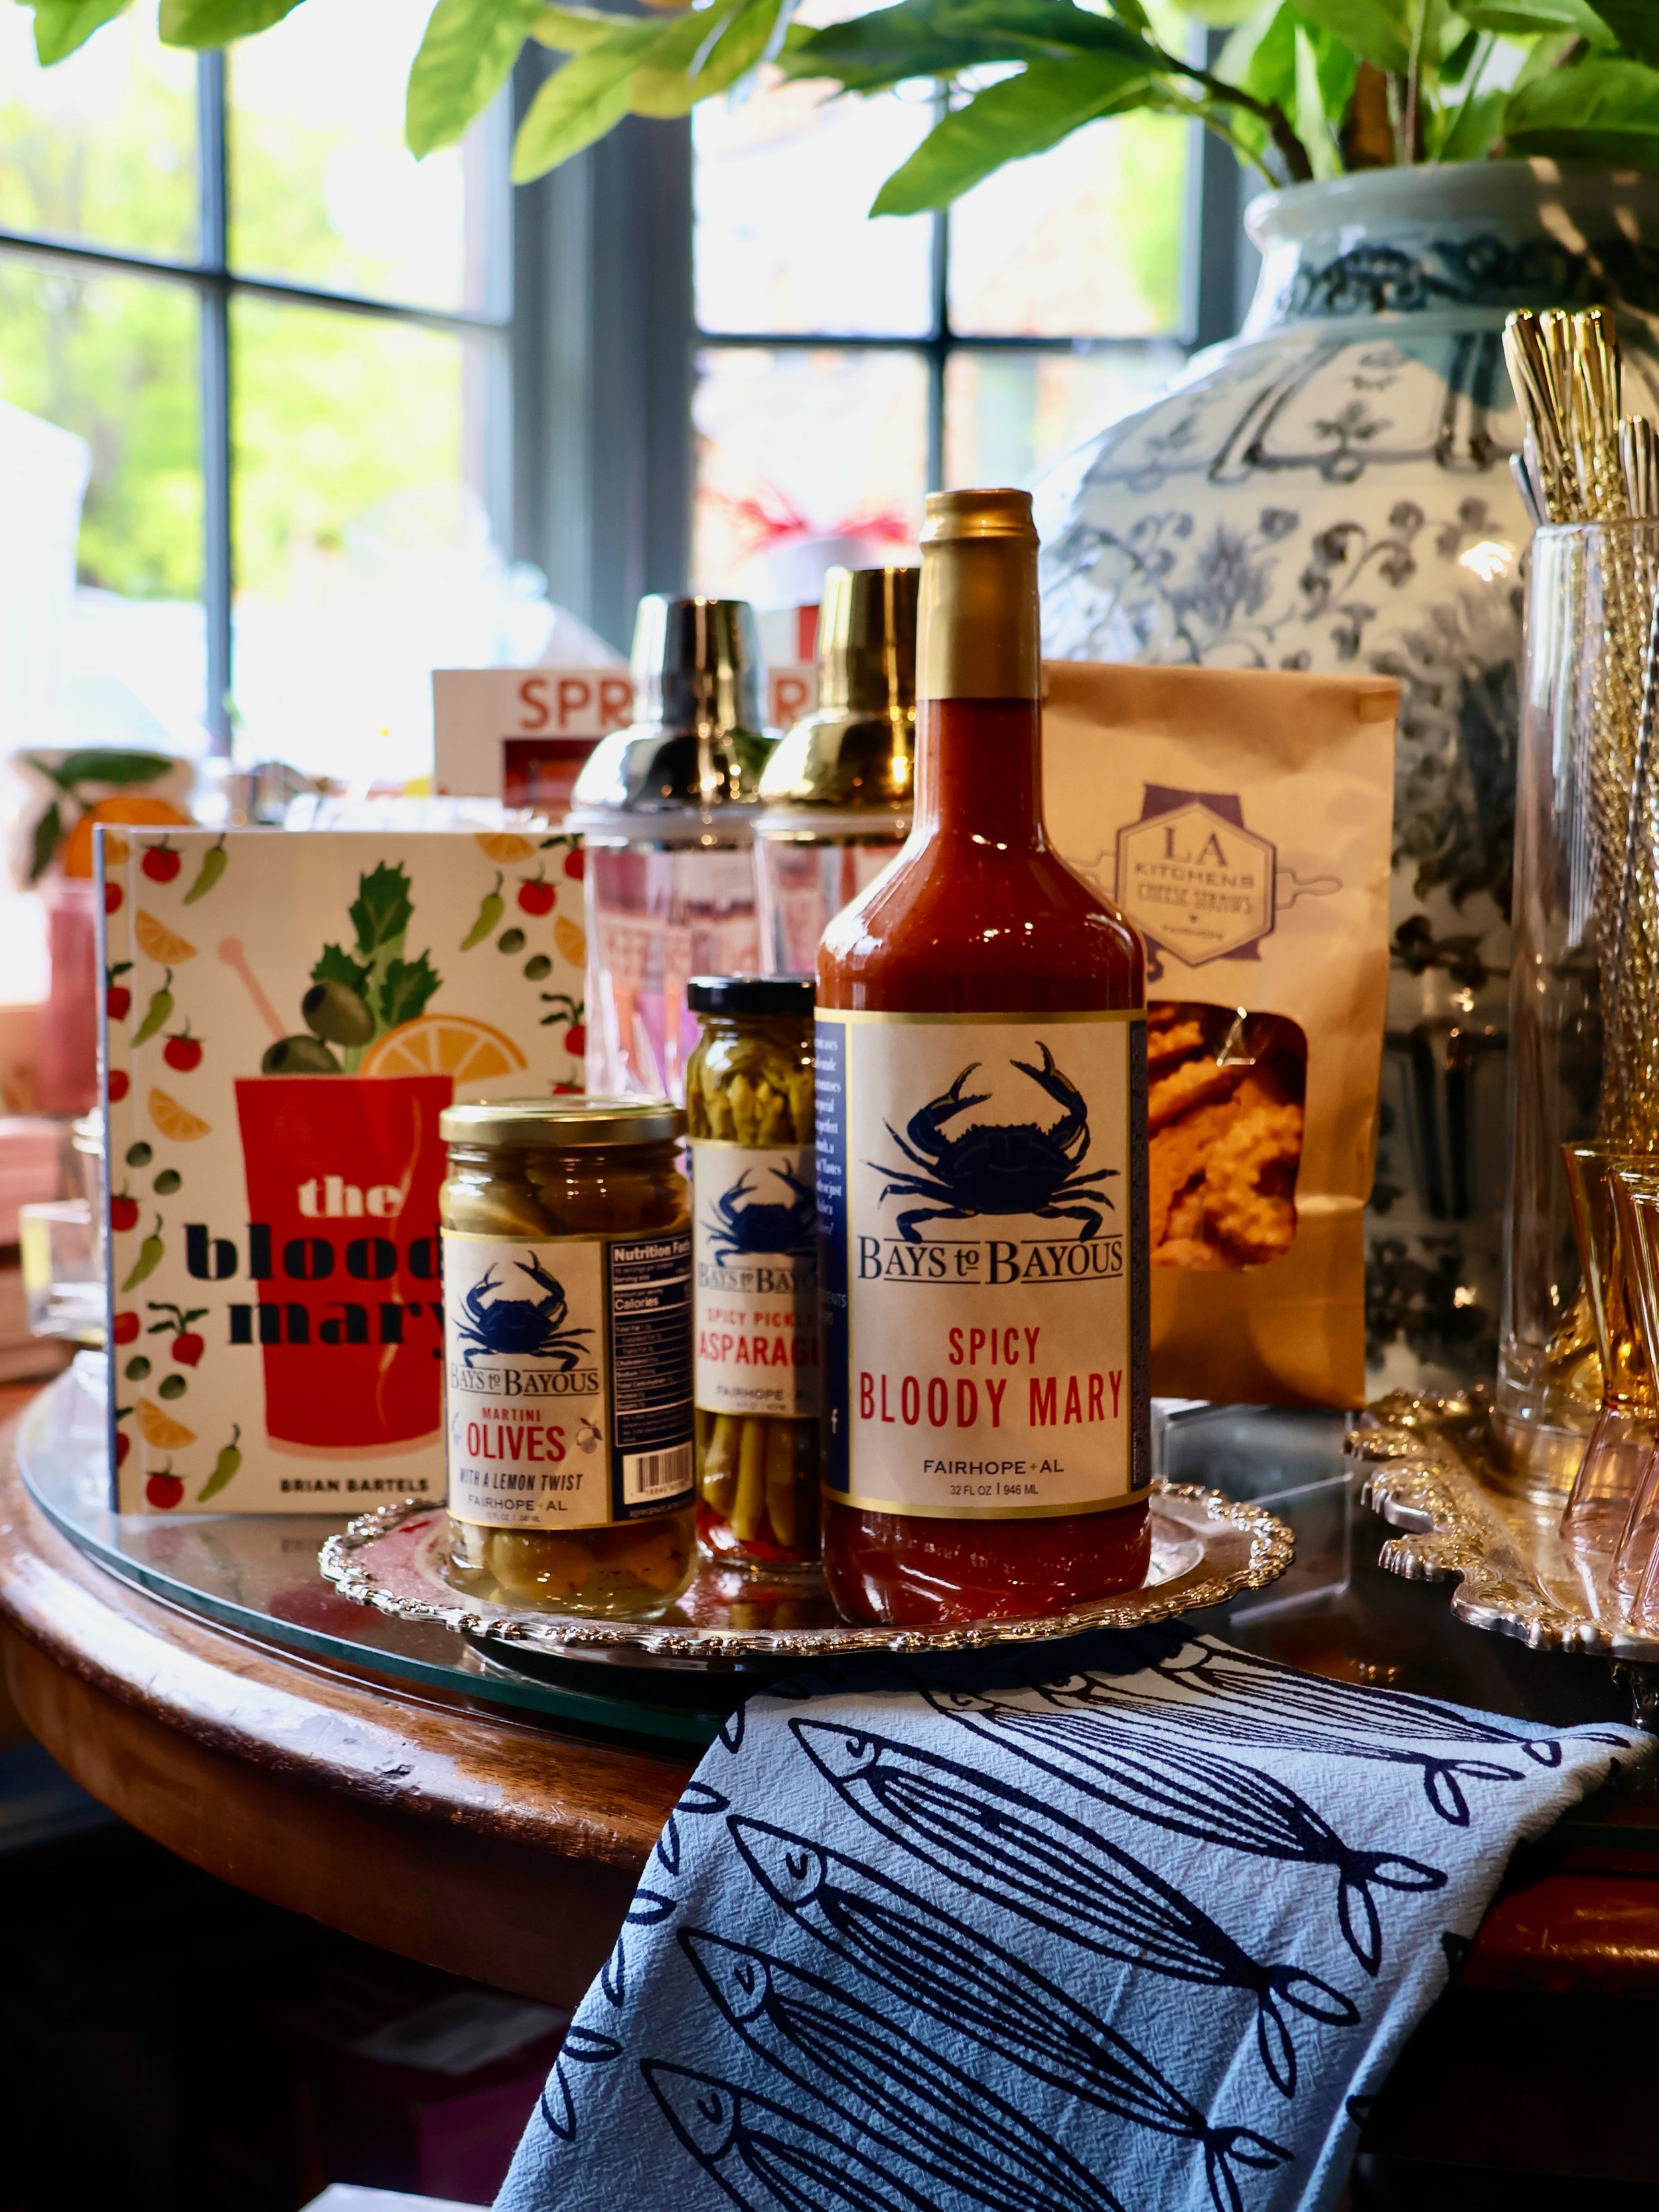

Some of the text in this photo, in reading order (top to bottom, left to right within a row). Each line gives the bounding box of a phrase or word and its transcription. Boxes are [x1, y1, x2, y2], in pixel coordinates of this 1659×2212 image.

[1164, 827, 1228, 866] LA
[1135, 862, 1254, 889] KITCHENS
[299, 1175, 401, 1218] the
[184, 1222, 443, 1281] blood
[614, 1245, 672, 1261] Nutrition
[858, 1236, 1123, 1284] BAYS to BAYOUS
[699, 1263, 738, 1289] BAYS
[757, 1268, 817, 1293] BAYO
[615, 1297, 660, 1310] Calories
[708, 1307, 815, 1328] SPICY PICKLE
[698, 1332, 819, 1367] ASPARAG
[949, 1327, 1040, 1365] SPICY
[451, 1363, 485, 1390] BAYS
[488, 1374, 500, 1389] to
[504, 1369, 599, 1396] BAYOUS
[860, 1370, 1123, 1428] BLOODY MARY
[482, 1408, 541, 1422] MARTINI
[467, 1422, 566, 1461] OLIVES
[460, 1468, 583, 1491] WITH A LEMON TWIST
[924, 1459, 1064, 1475] FAIRHOPE AL
[280, 1479, 429, 1493] BRIAN BARTELS
[950, 1484, 1039, 1495] 32 FL OZ 946 ML
[467, 1495, 568, 1511] FAIRHOPE AL
